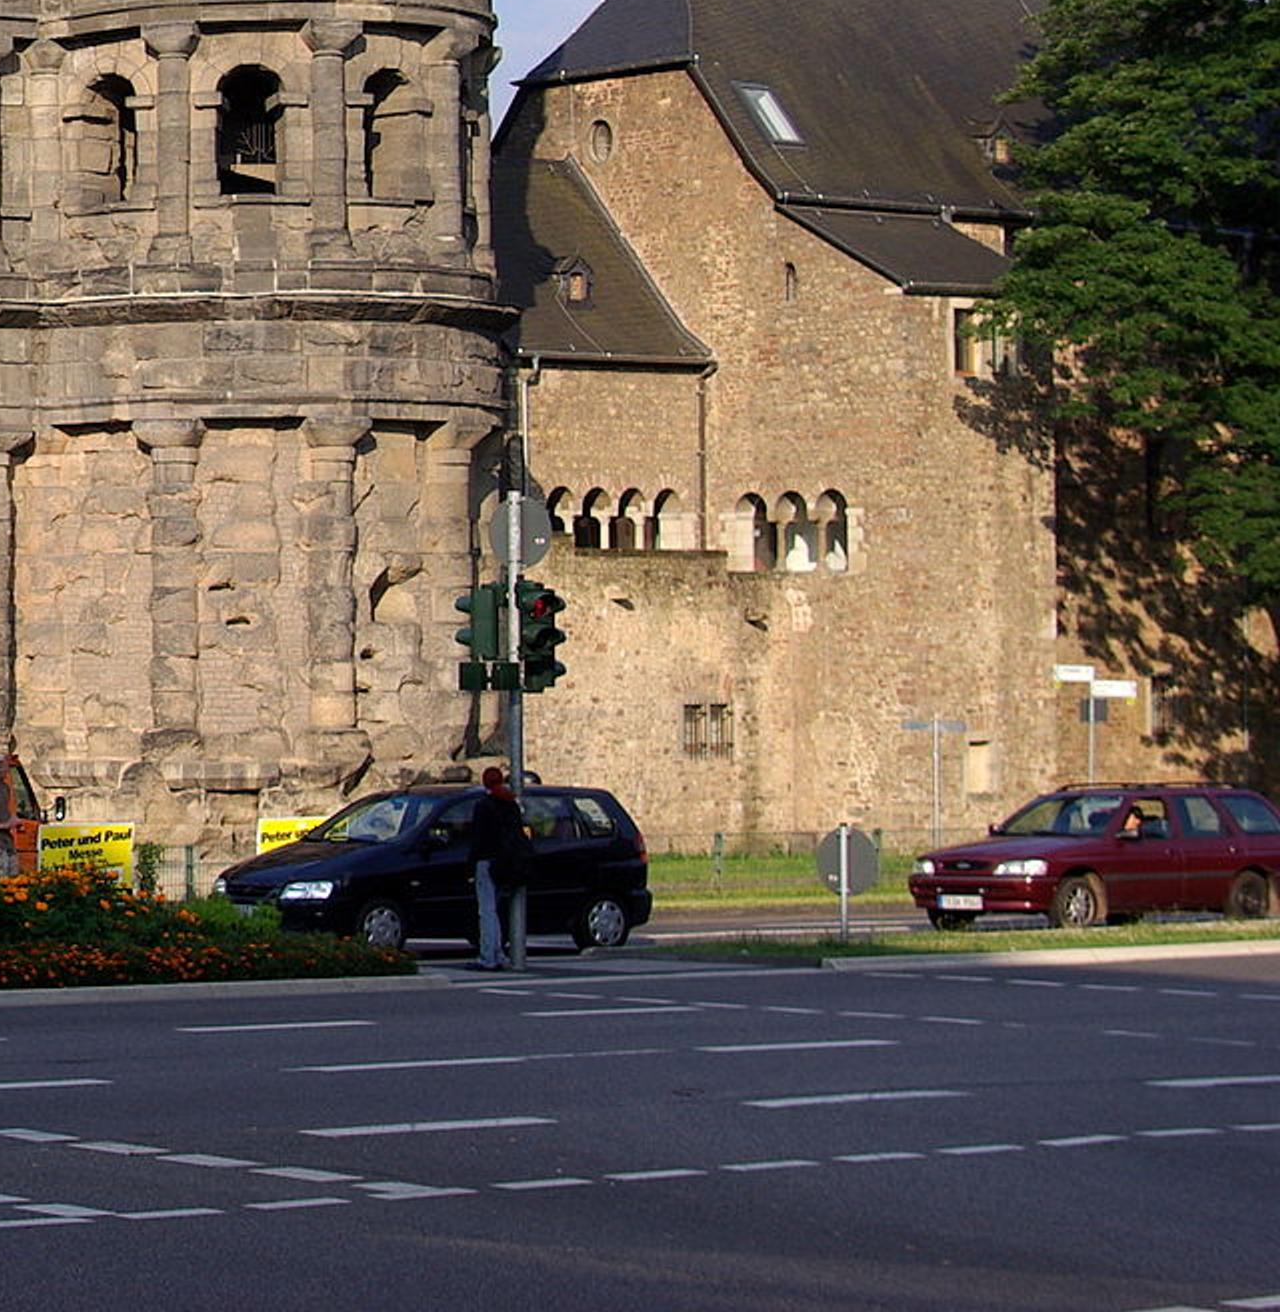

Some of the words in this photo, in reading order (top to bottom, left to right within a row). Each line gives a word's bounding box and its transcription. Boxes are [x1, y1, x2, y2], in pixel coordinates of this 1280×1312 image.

[41, 837, 75, 850] Peter
[78, 832, 102, 845] und
[104, 828, 132, 842] Paul
[261, 831, 292, 843] Peter
[69, 848, 103, 860] Messe
